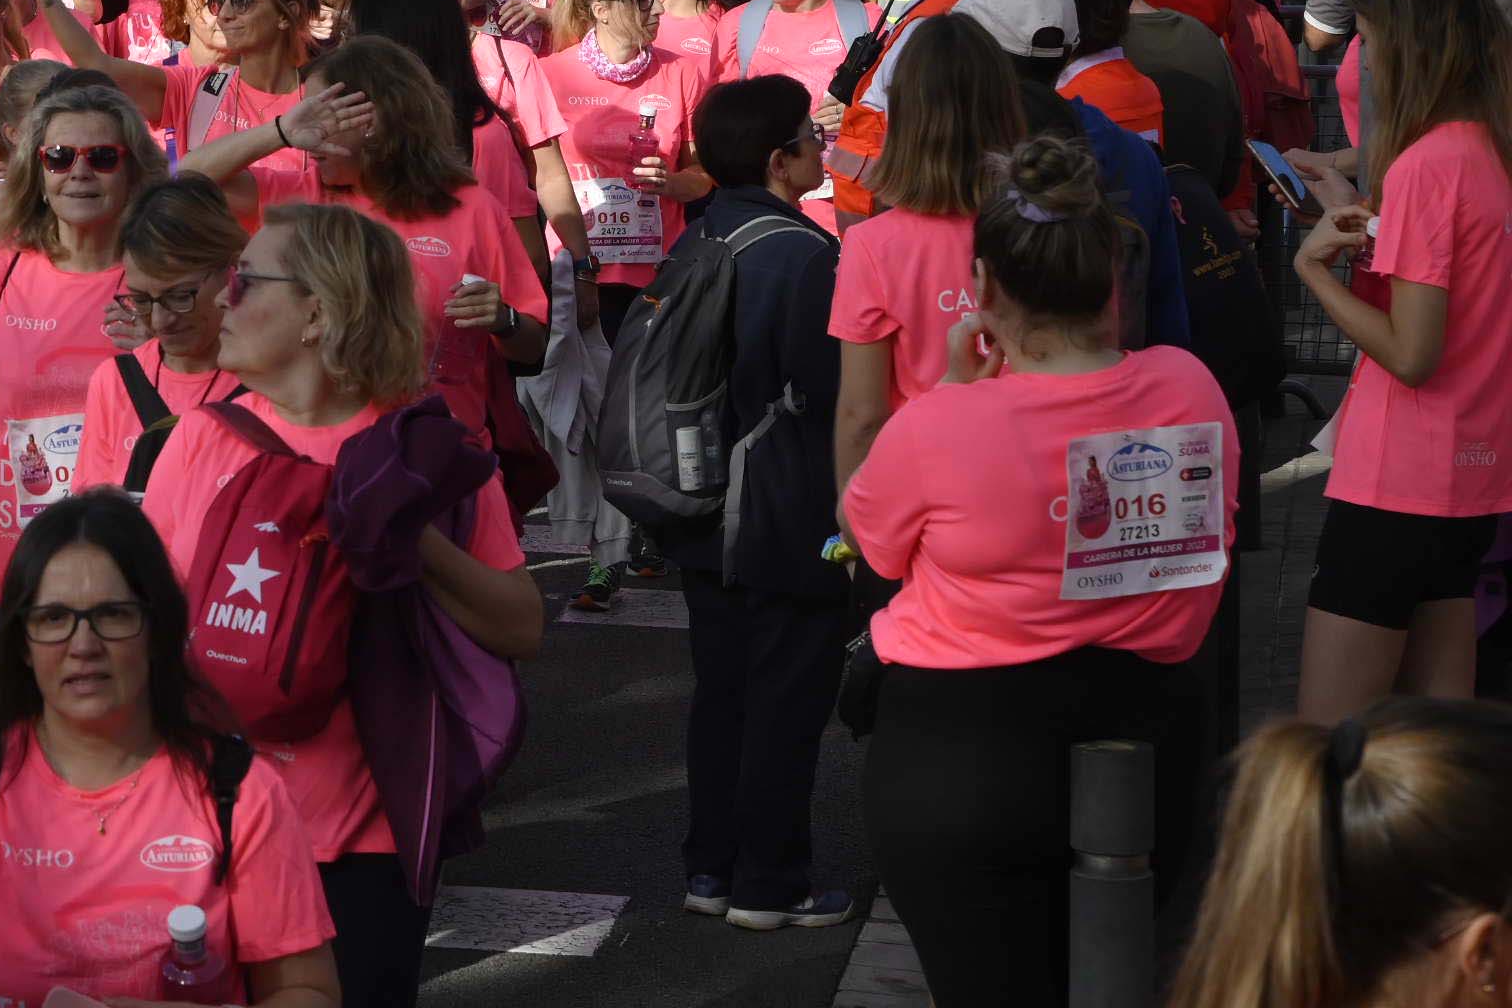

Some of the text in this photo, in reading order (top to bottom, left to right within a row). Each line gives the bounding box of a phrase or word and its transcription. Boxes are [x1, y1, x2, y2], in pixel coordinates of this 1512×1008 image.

[568, 95, 609, 106] OYSHO
[598, 211, 630, 224] 016
[601, 227, 627, 235] 24723
[1179, 447, 1210, 457] SUMA
[1112, 458, 1167, 475] ASTURIANA
[1115, 493, 1167, 520] 016
[1119, 524, 1160, 541] 27213
[1083, 551, 1122, 563] CARRERA
[1123, 549, 1136, 557] DE
[1138, 547, 1150, 556] LA
[1151, 543, 1184, 555] MUJER
[1077, 563, 1215, 589] OYSHO Santander
[206, 602, 268, 635] INMA
[206, 649, 248, 664] Quechua
